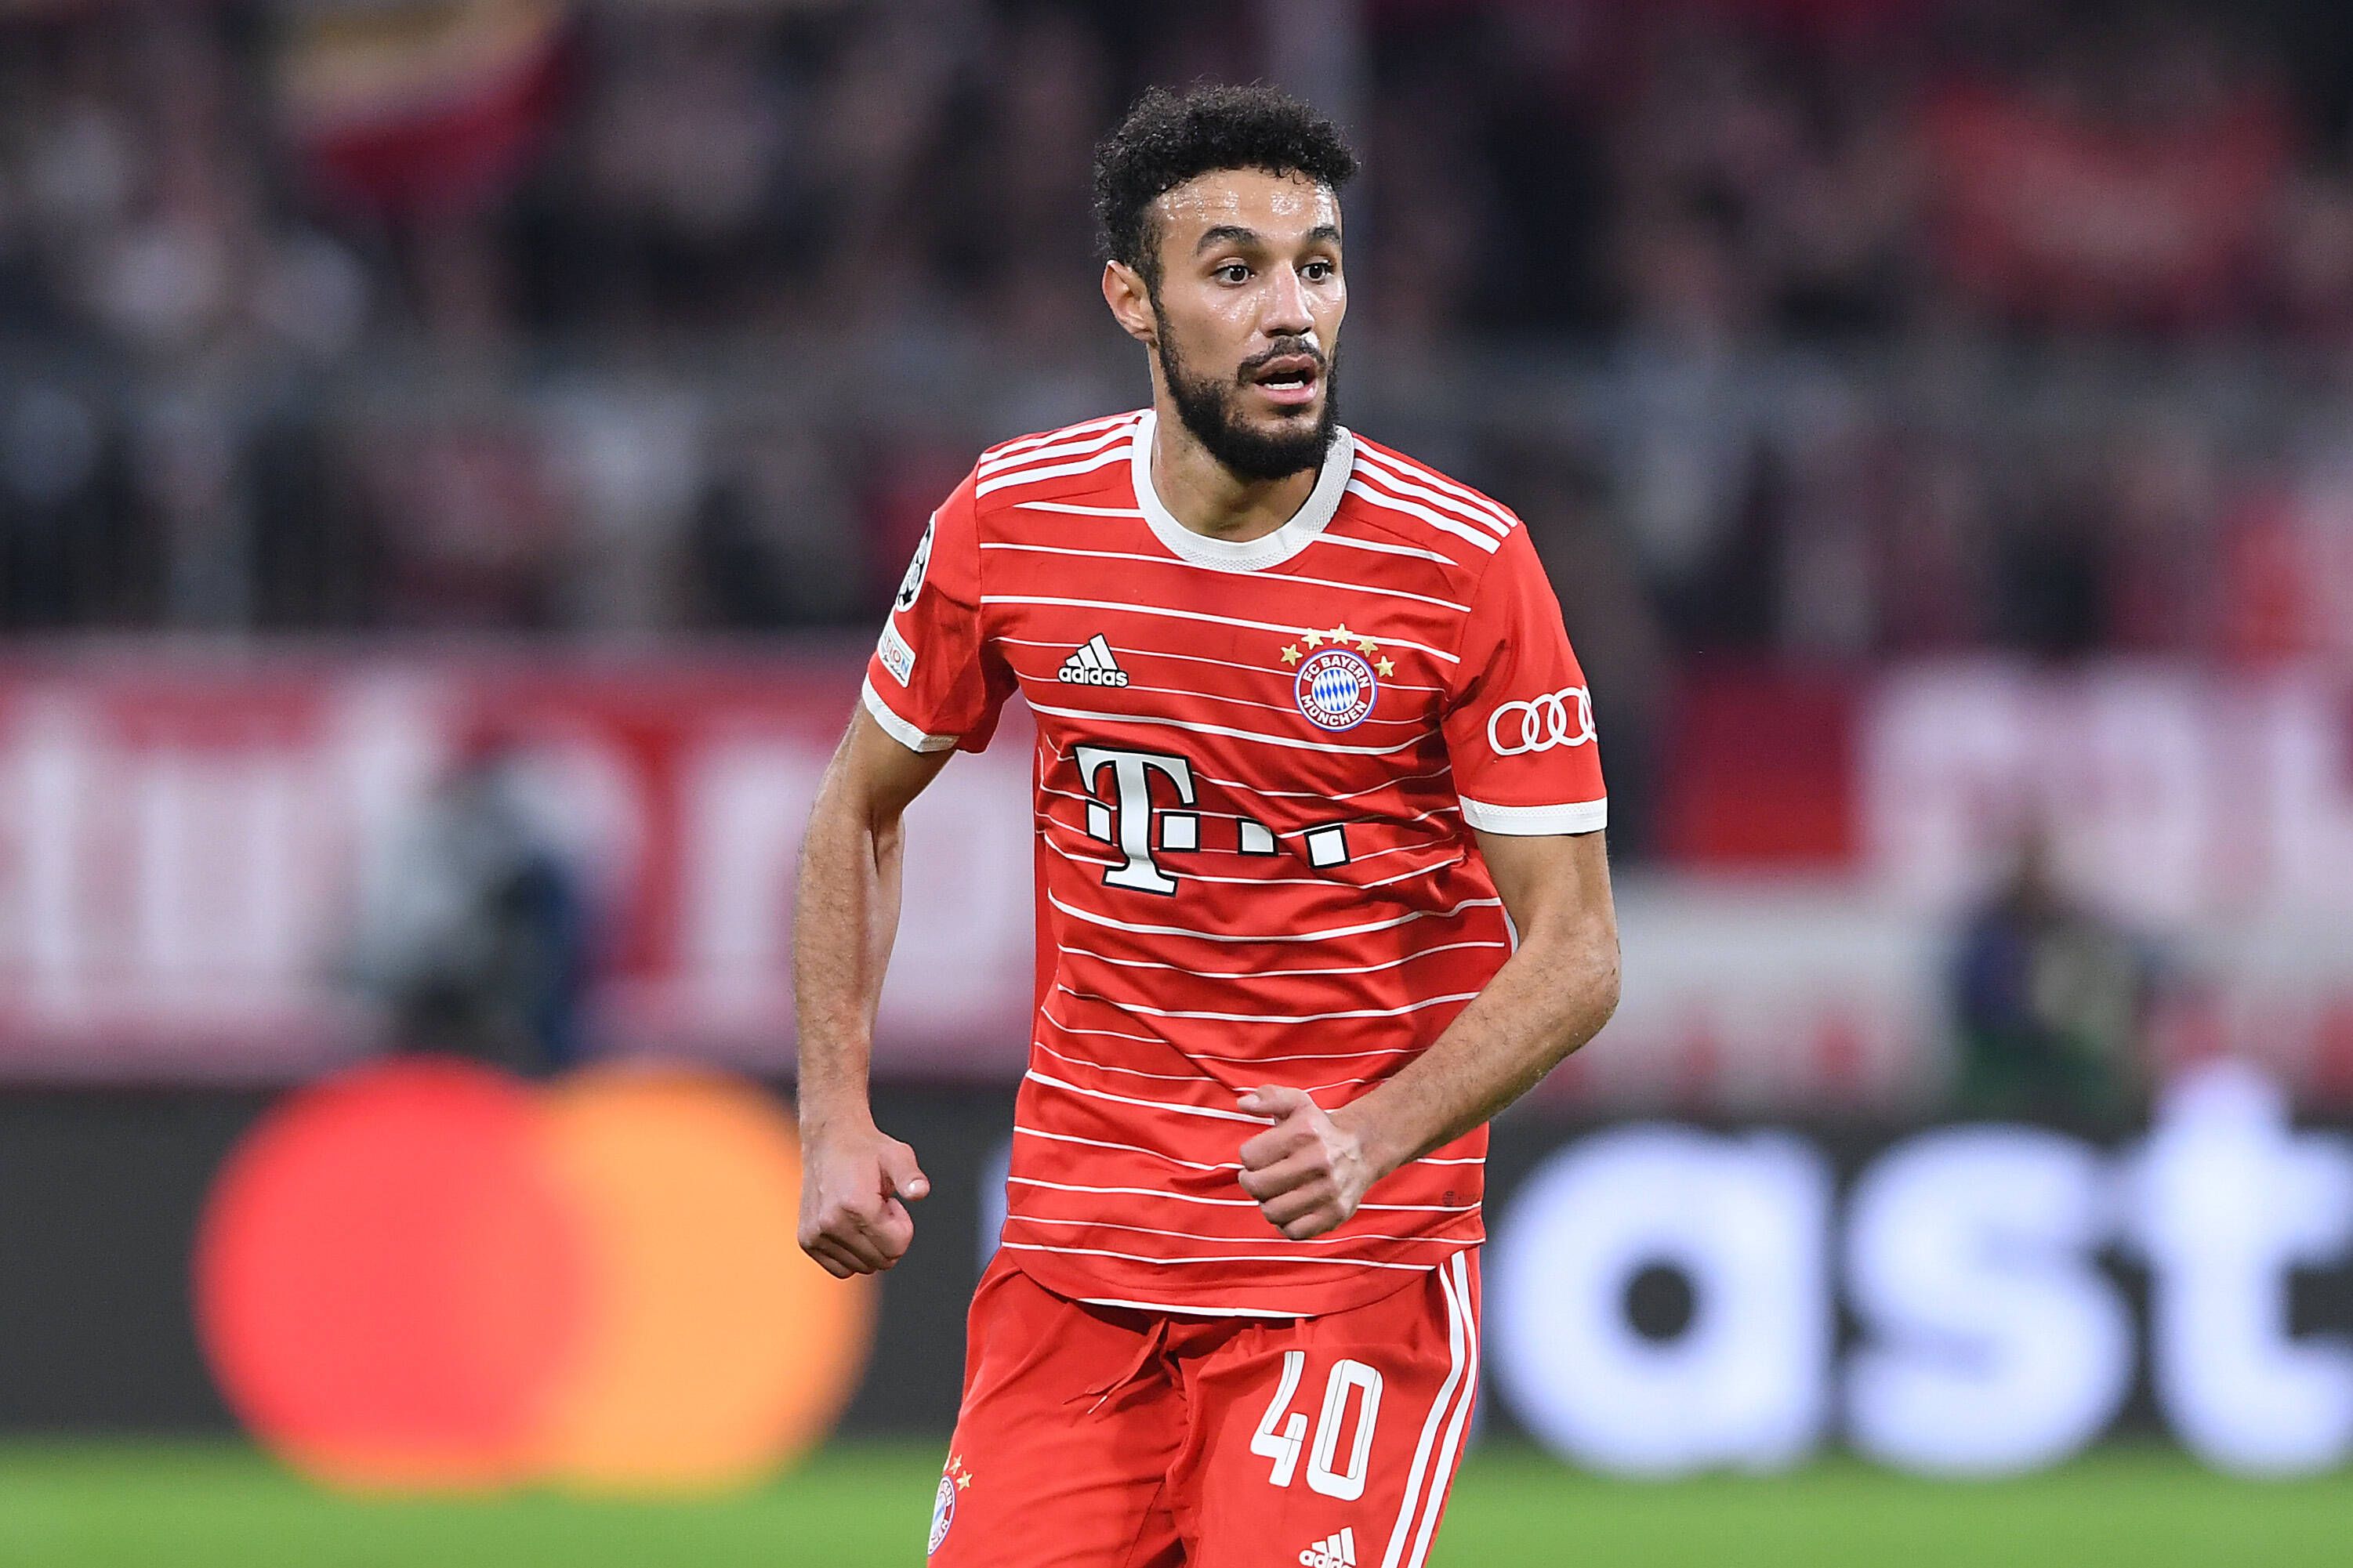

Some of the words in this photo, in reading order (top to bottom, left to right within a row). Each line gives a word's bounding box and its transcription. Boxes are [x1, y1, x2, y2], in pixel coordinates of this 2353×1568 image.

[1058, 665, 1128, 687] adidas
[1303, 663, 1320, 683] FC
[1320, 655, 1370, 689] BAYERN
[1496, 1075, 2353, 1476] ast
[1249, 1350, 1383, 1502] 40
